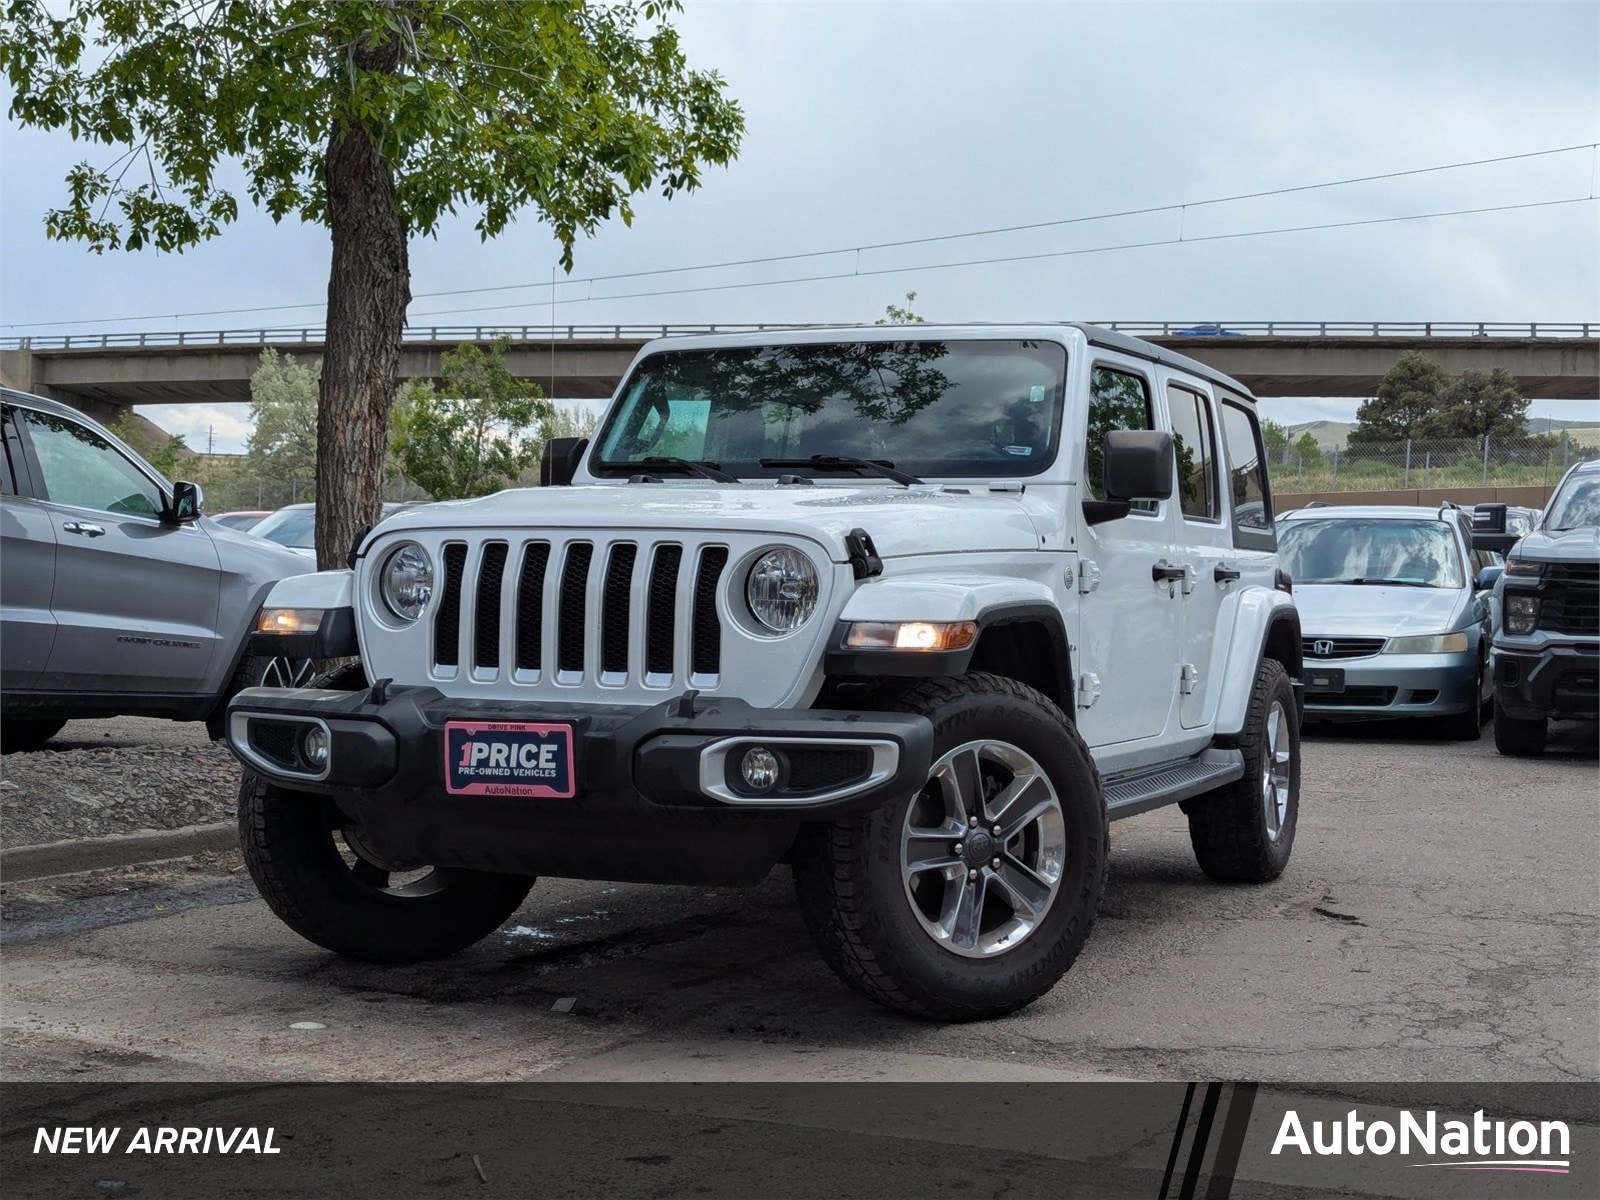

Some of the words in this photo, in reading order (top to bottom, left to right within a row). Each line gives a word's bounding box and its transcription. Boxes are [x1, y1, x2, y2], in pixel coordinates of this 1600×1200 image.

[487, 723, 508, 731] DRIVE
[458, 767, 511, 776] PRE-OWNED
[513, 768, 557, 777] VEHICLES
[484, 785, 533, 795] AutoNation
